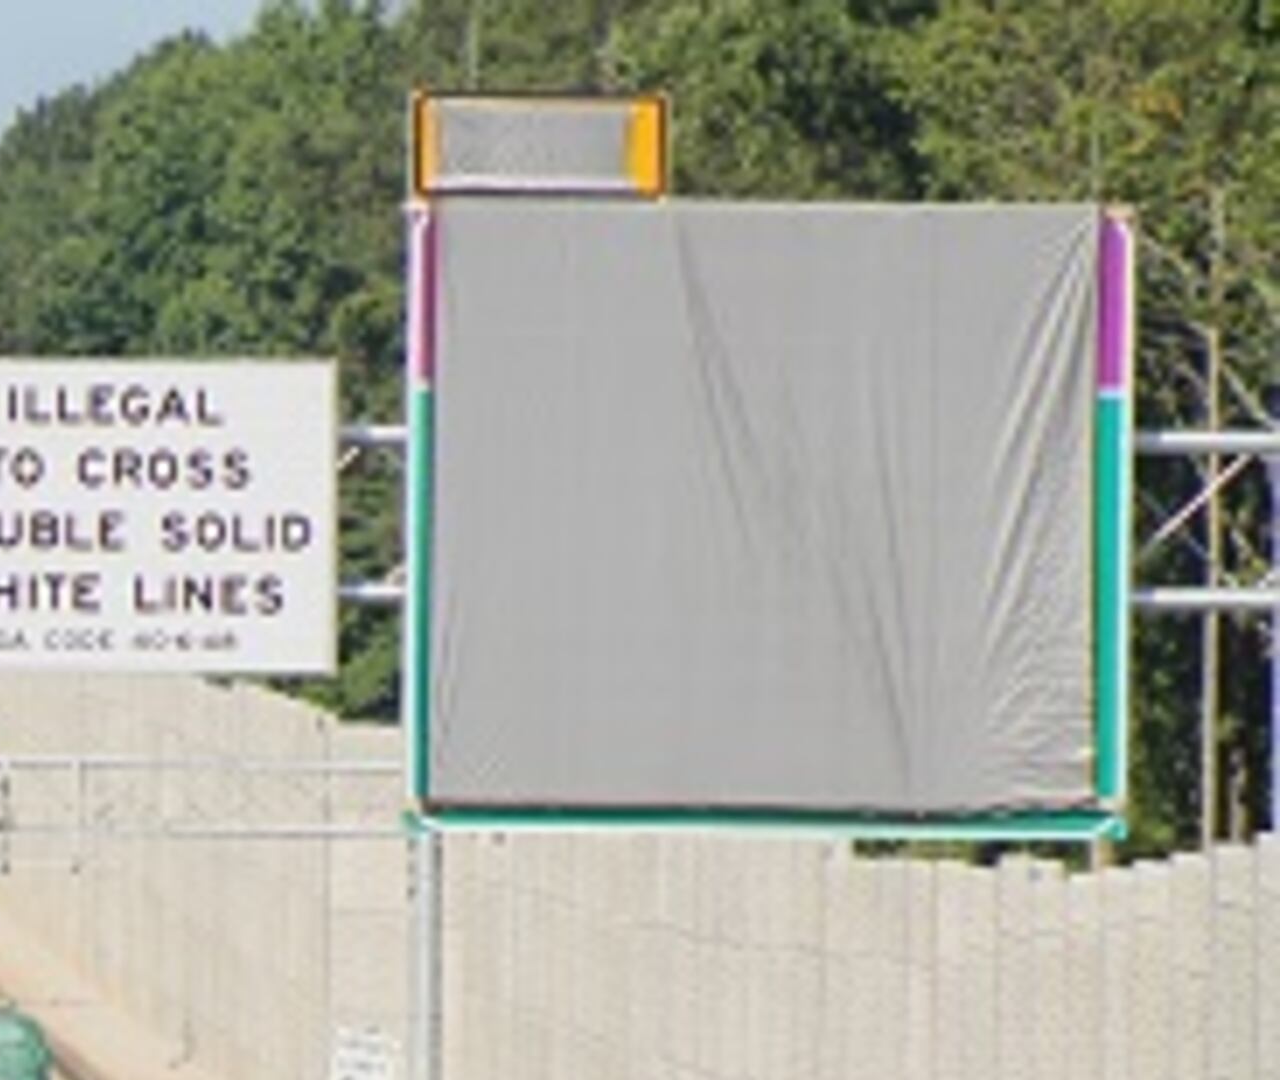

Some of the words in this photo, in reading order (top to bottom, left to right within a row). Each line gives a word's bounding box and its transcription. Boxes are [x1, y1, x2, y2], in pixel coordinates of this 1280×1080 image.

[7, 385, 222, 427] ILLEGAL
[77, 446, 252, 491] CROSS
[160, 511, 313, 553] SOLID
[132, 574, 285, 616] LINES
